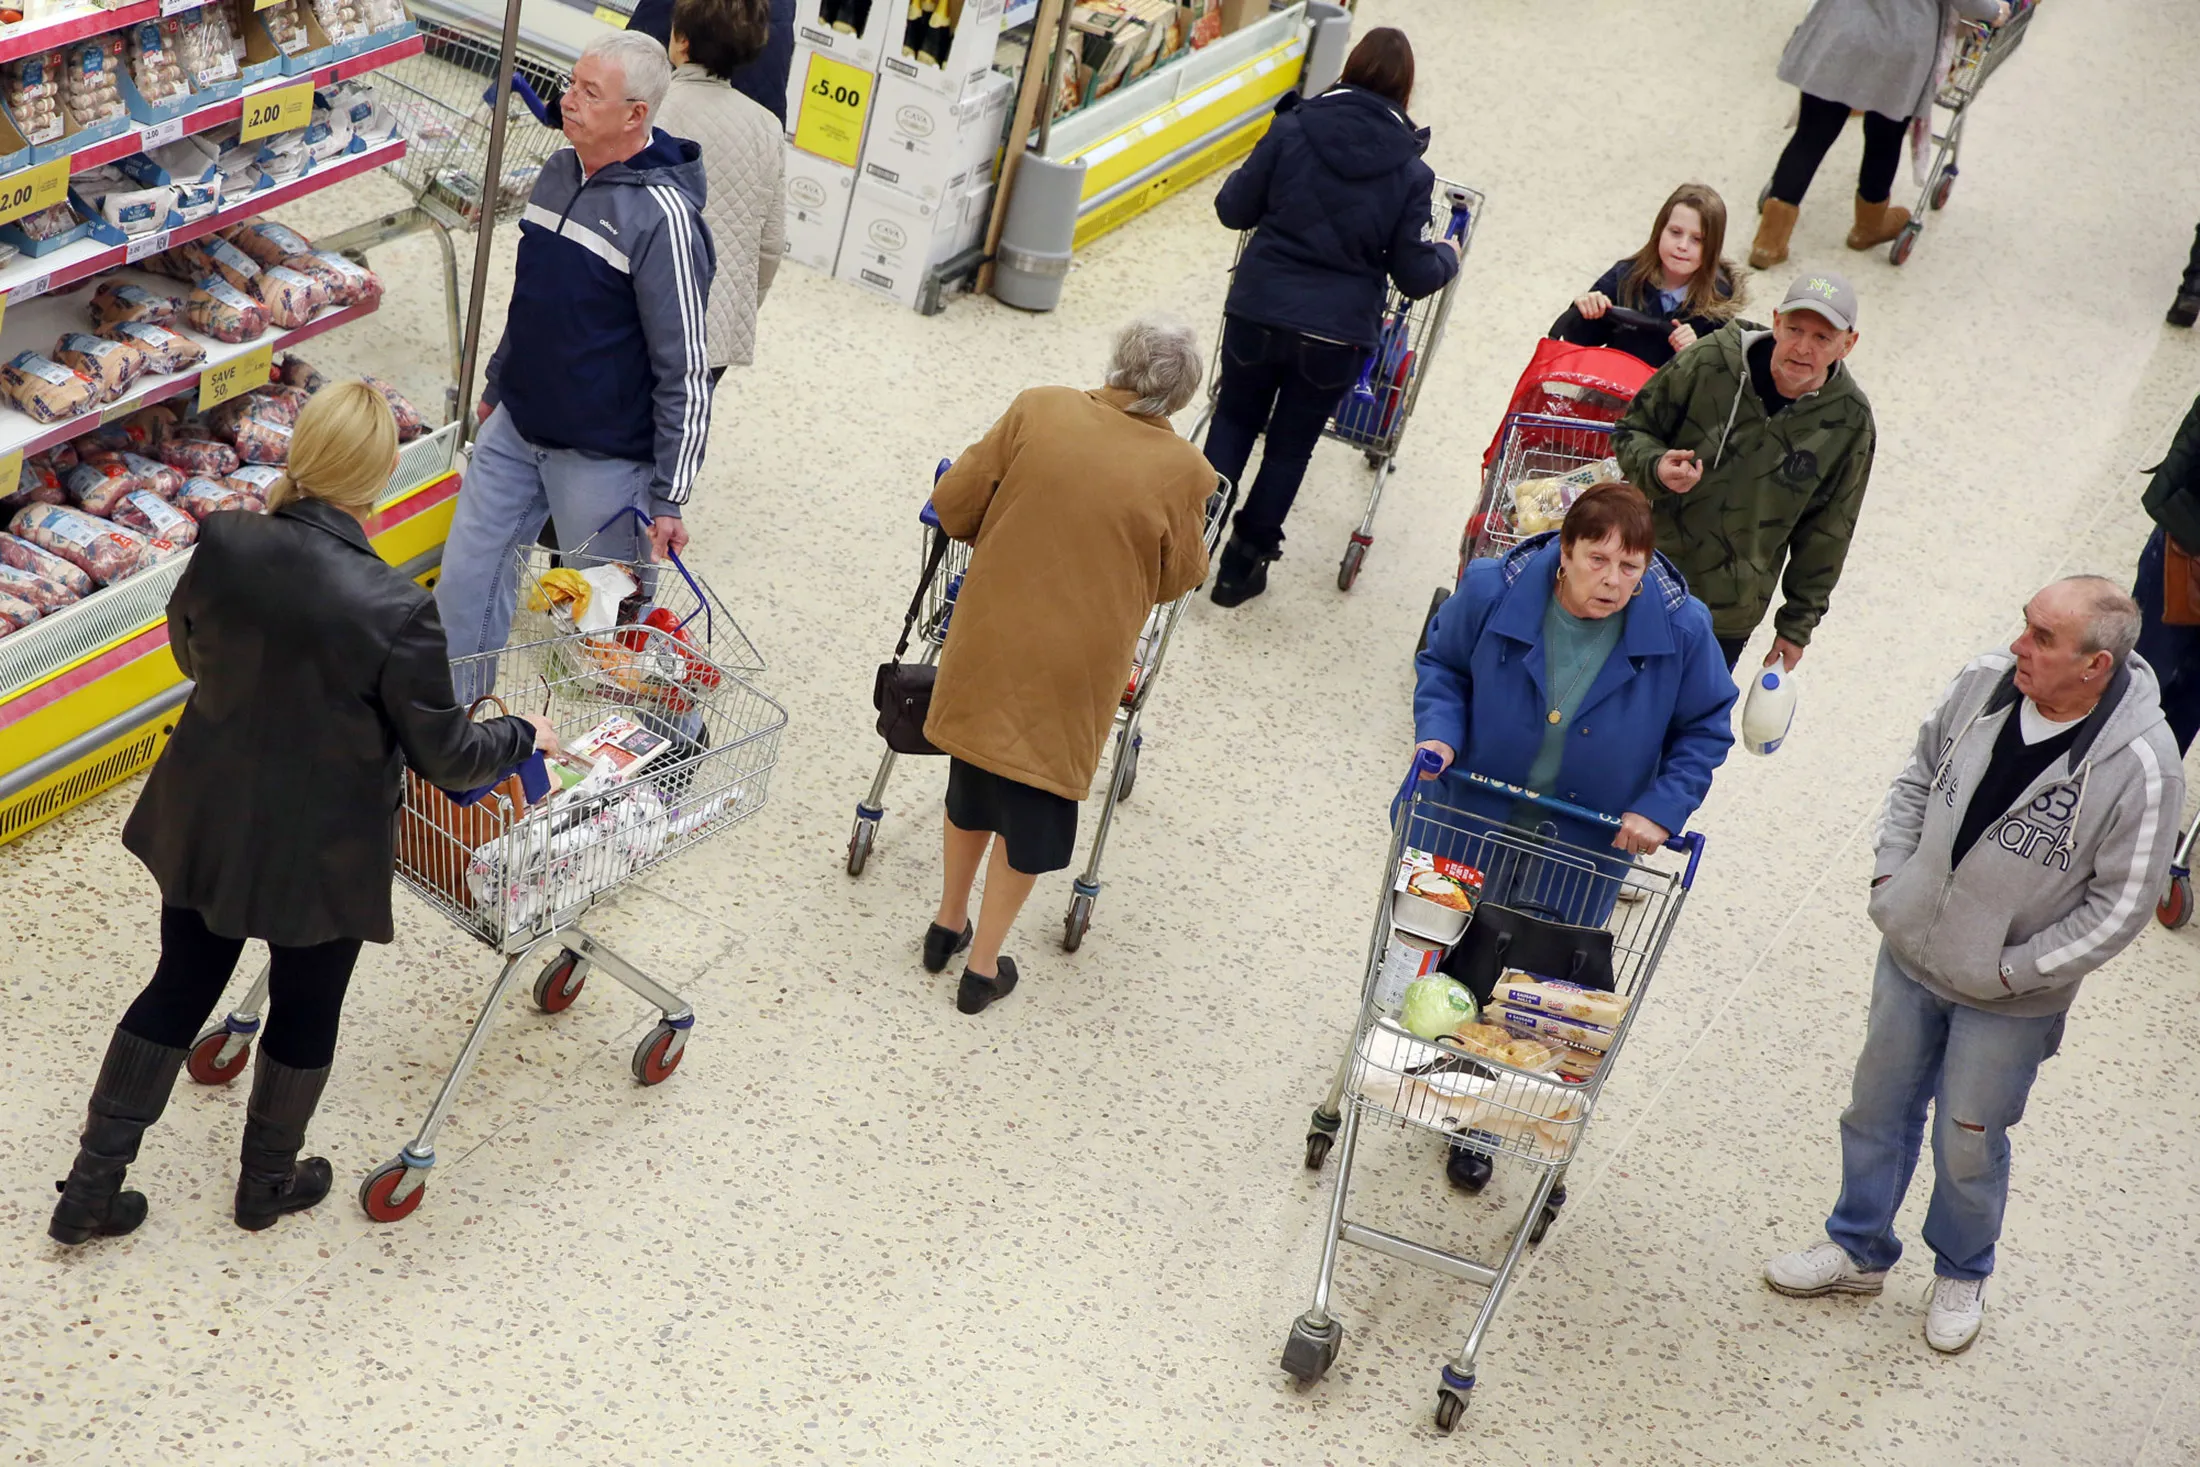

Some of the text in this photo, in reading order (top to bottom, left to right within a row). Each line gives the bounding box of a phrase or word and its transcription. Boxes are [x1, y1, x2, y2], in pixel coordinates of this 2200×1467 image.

[811, 79, 860, 107] £5.00
[248, 104, 280, 128] £2.00
[904, 110, 928, 124] CAVA
[796, 181, 819, 194] CAVA
[876, 224, 899, 238] CAVA
[1805, 278, 1839, 300] NY
[211, 366, 236, 386] SAVE
